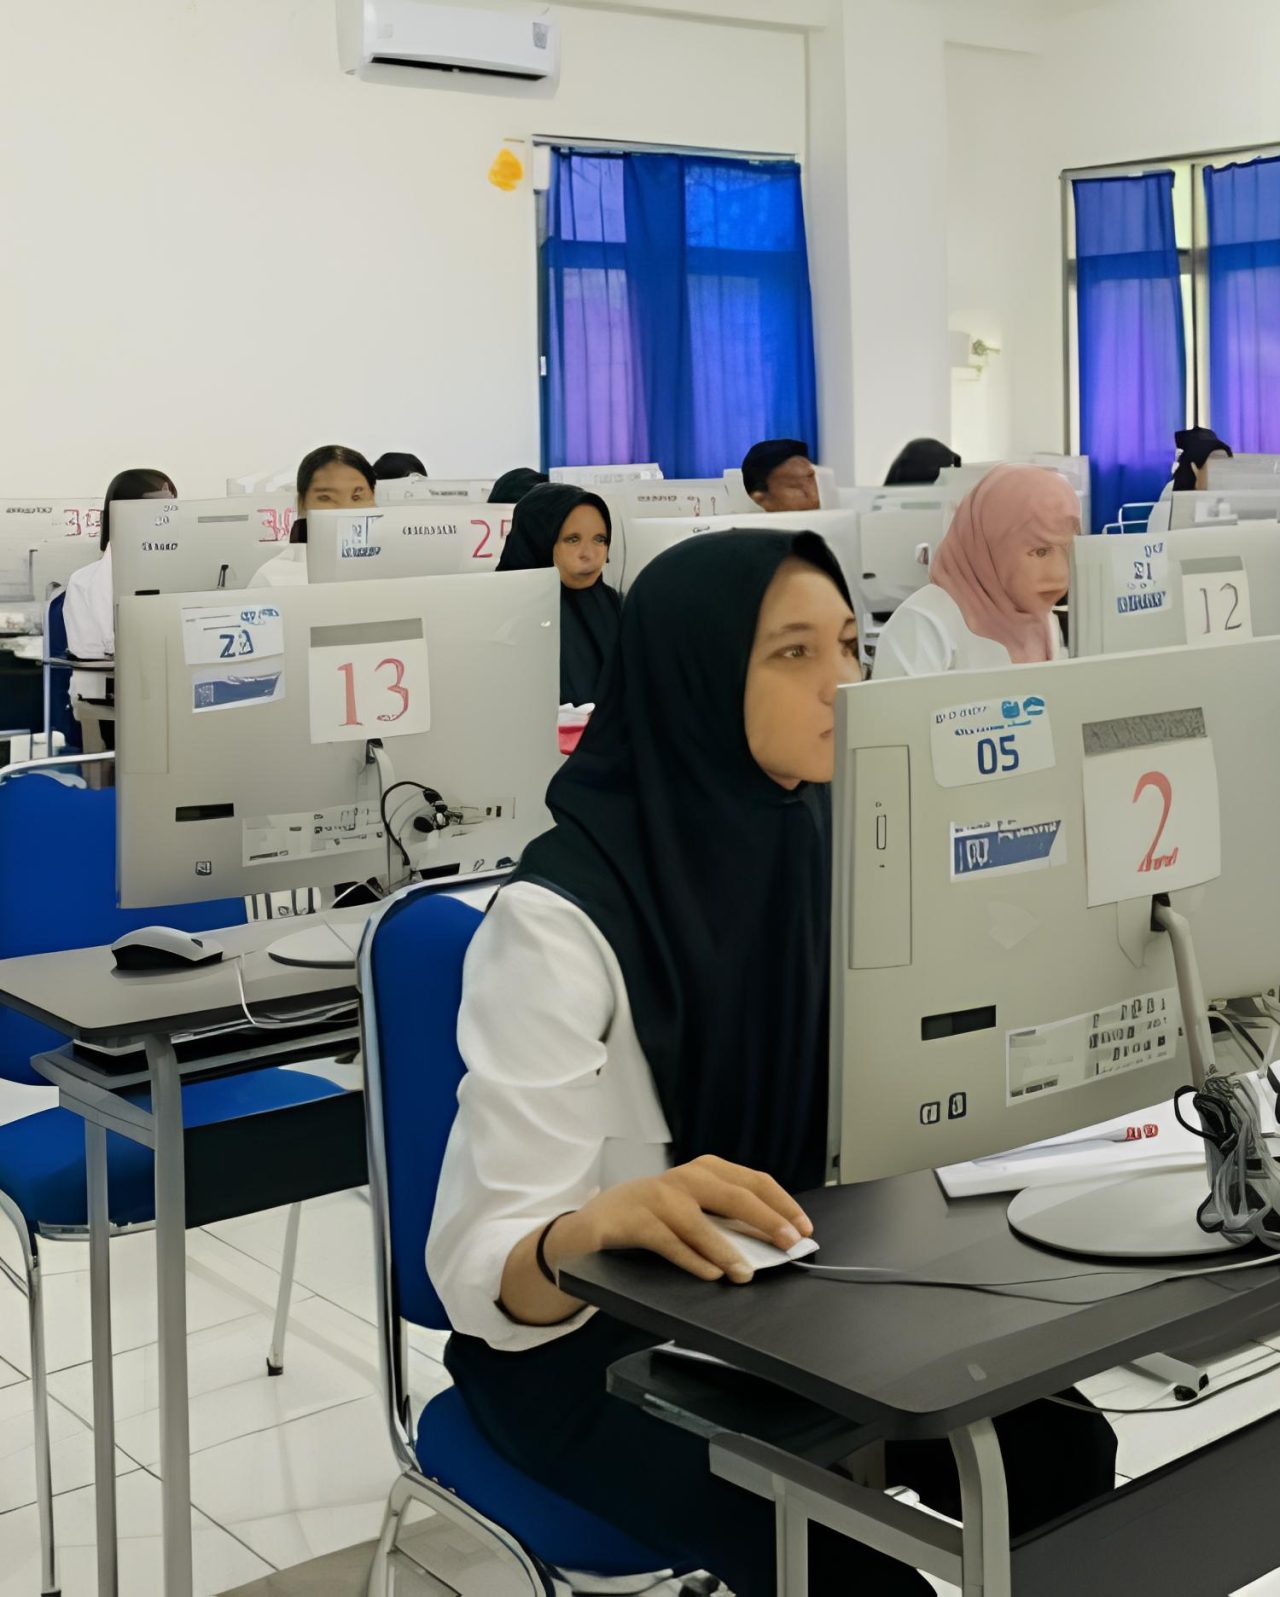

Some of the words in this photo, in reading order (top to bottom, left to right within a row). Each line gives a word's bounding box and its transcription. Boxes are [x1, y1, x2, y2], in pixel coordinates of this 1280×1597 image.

[1199, 582, 1242, 634] 12
[336, 657, 410, 727] 13
[976, 734, 1020, 776] 05
[1132, 770, 1178, 872] 2
